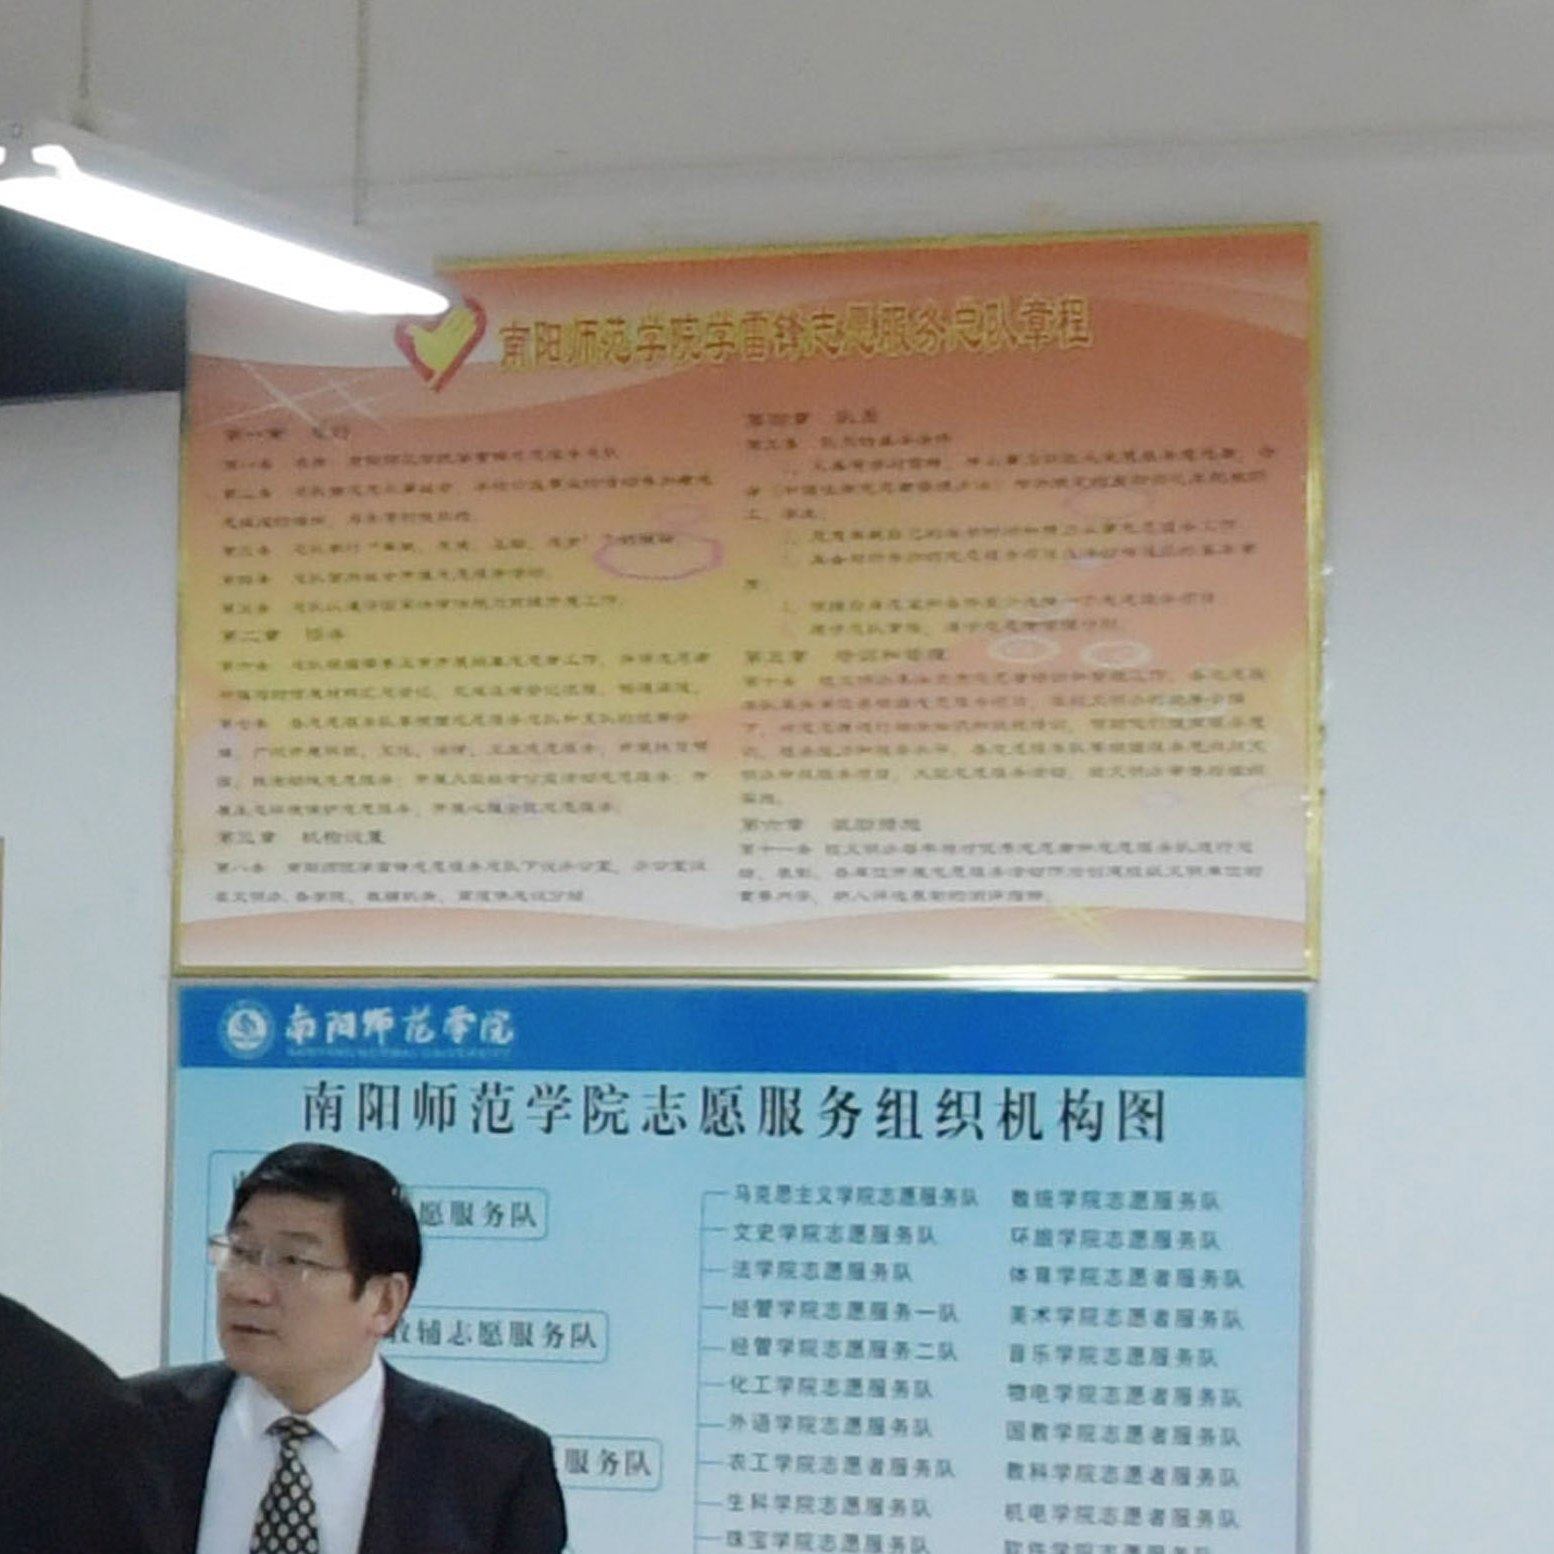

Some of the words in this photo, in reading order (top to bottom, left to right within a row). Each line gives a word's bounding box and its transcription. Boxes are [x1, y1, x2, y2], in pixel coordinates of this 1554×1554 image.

[284, 1003, 515, 1045] 南阳师范学院
[304, 1079, 1165, 1143] 南阳师范学院志愿服务组织机构图
